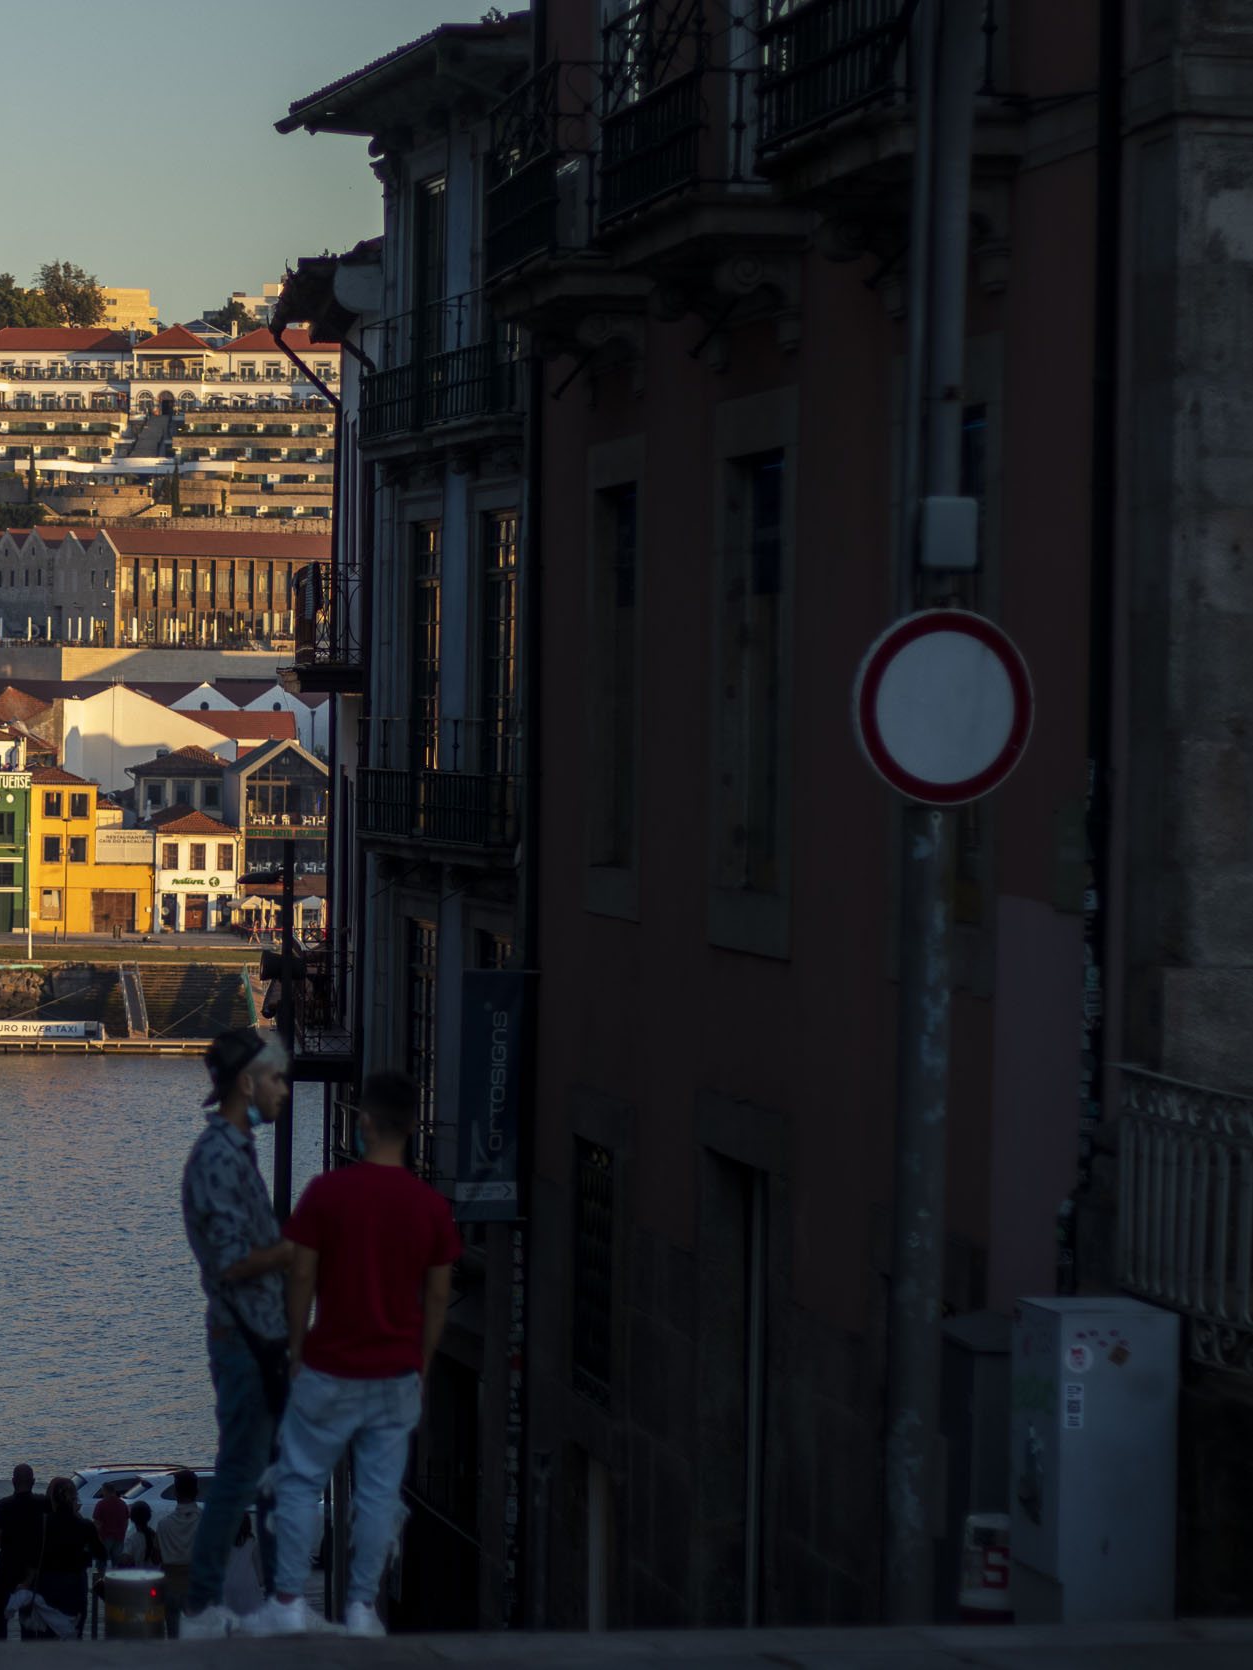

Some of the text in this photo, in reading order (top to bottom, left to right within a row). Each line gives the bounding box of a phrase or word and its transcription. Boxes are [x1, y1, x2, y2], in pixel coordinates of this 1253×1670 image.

[171, 877, 206, 886] natura
[21, 1024, 52, 1033] RIVER
[55, 1024, 78, 1034] TAXI
